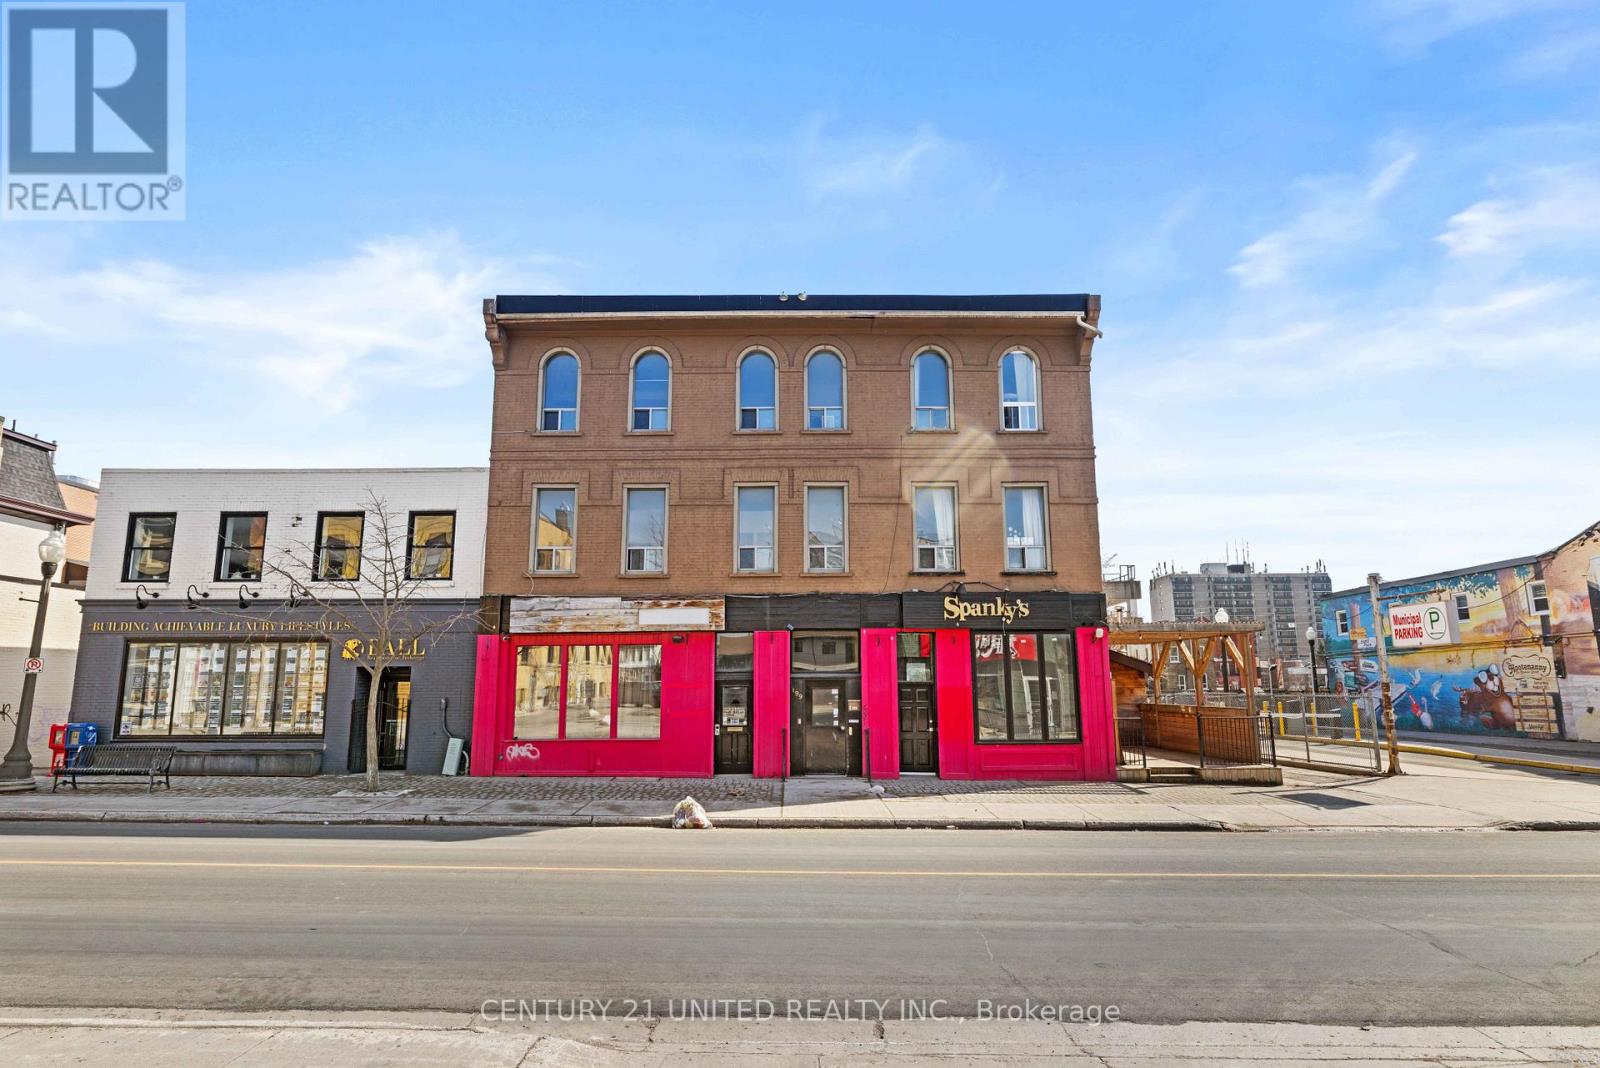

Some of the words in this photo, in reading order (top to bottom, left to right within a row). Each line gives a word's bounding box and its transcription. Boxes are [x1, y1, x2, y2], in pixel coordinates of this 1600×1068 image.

[943, 596, 1030, 624] Spanky's
[1393, 612, 1421, 627] Municipal
[1395, 627, 1423, 640] PARKING
